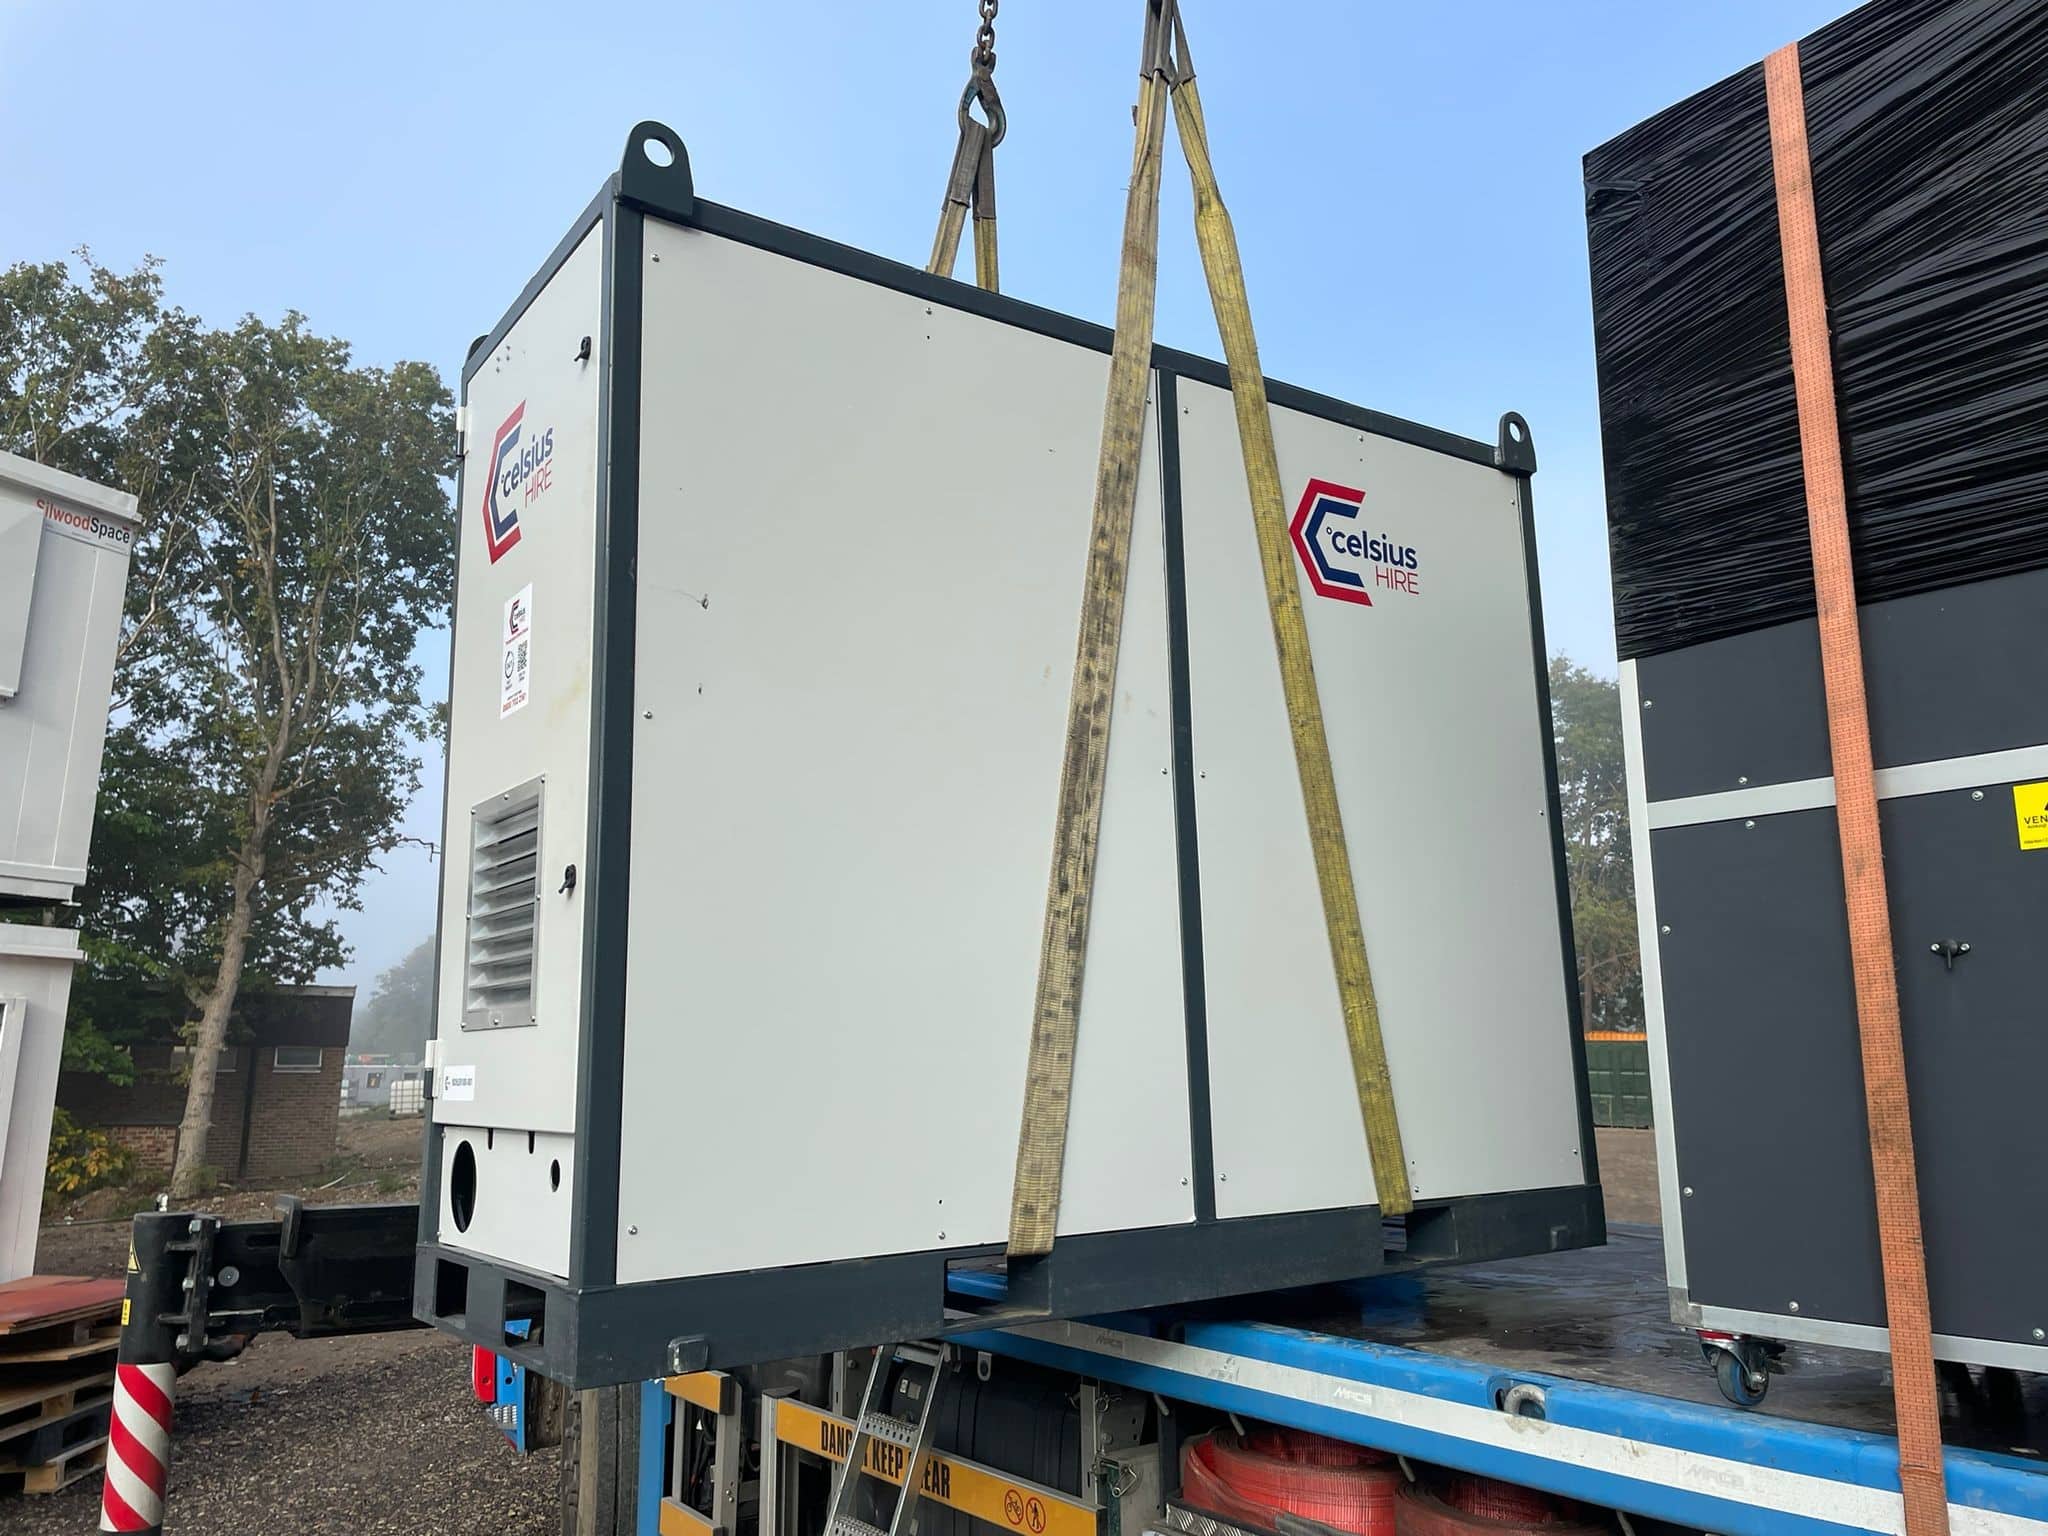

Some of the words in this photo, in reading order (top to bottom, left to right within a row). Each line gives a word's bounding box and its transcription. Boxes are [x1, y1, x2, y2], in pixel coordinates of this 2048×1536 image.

[524, 458, 553, 509] HIRE
[1375, 565, 1420, 595] HIRE
[820, 1420, 868, 1467] DANG
[872, 1437, 904, 1480] KEEP
[907, 1451, 951, 1500] EAR
